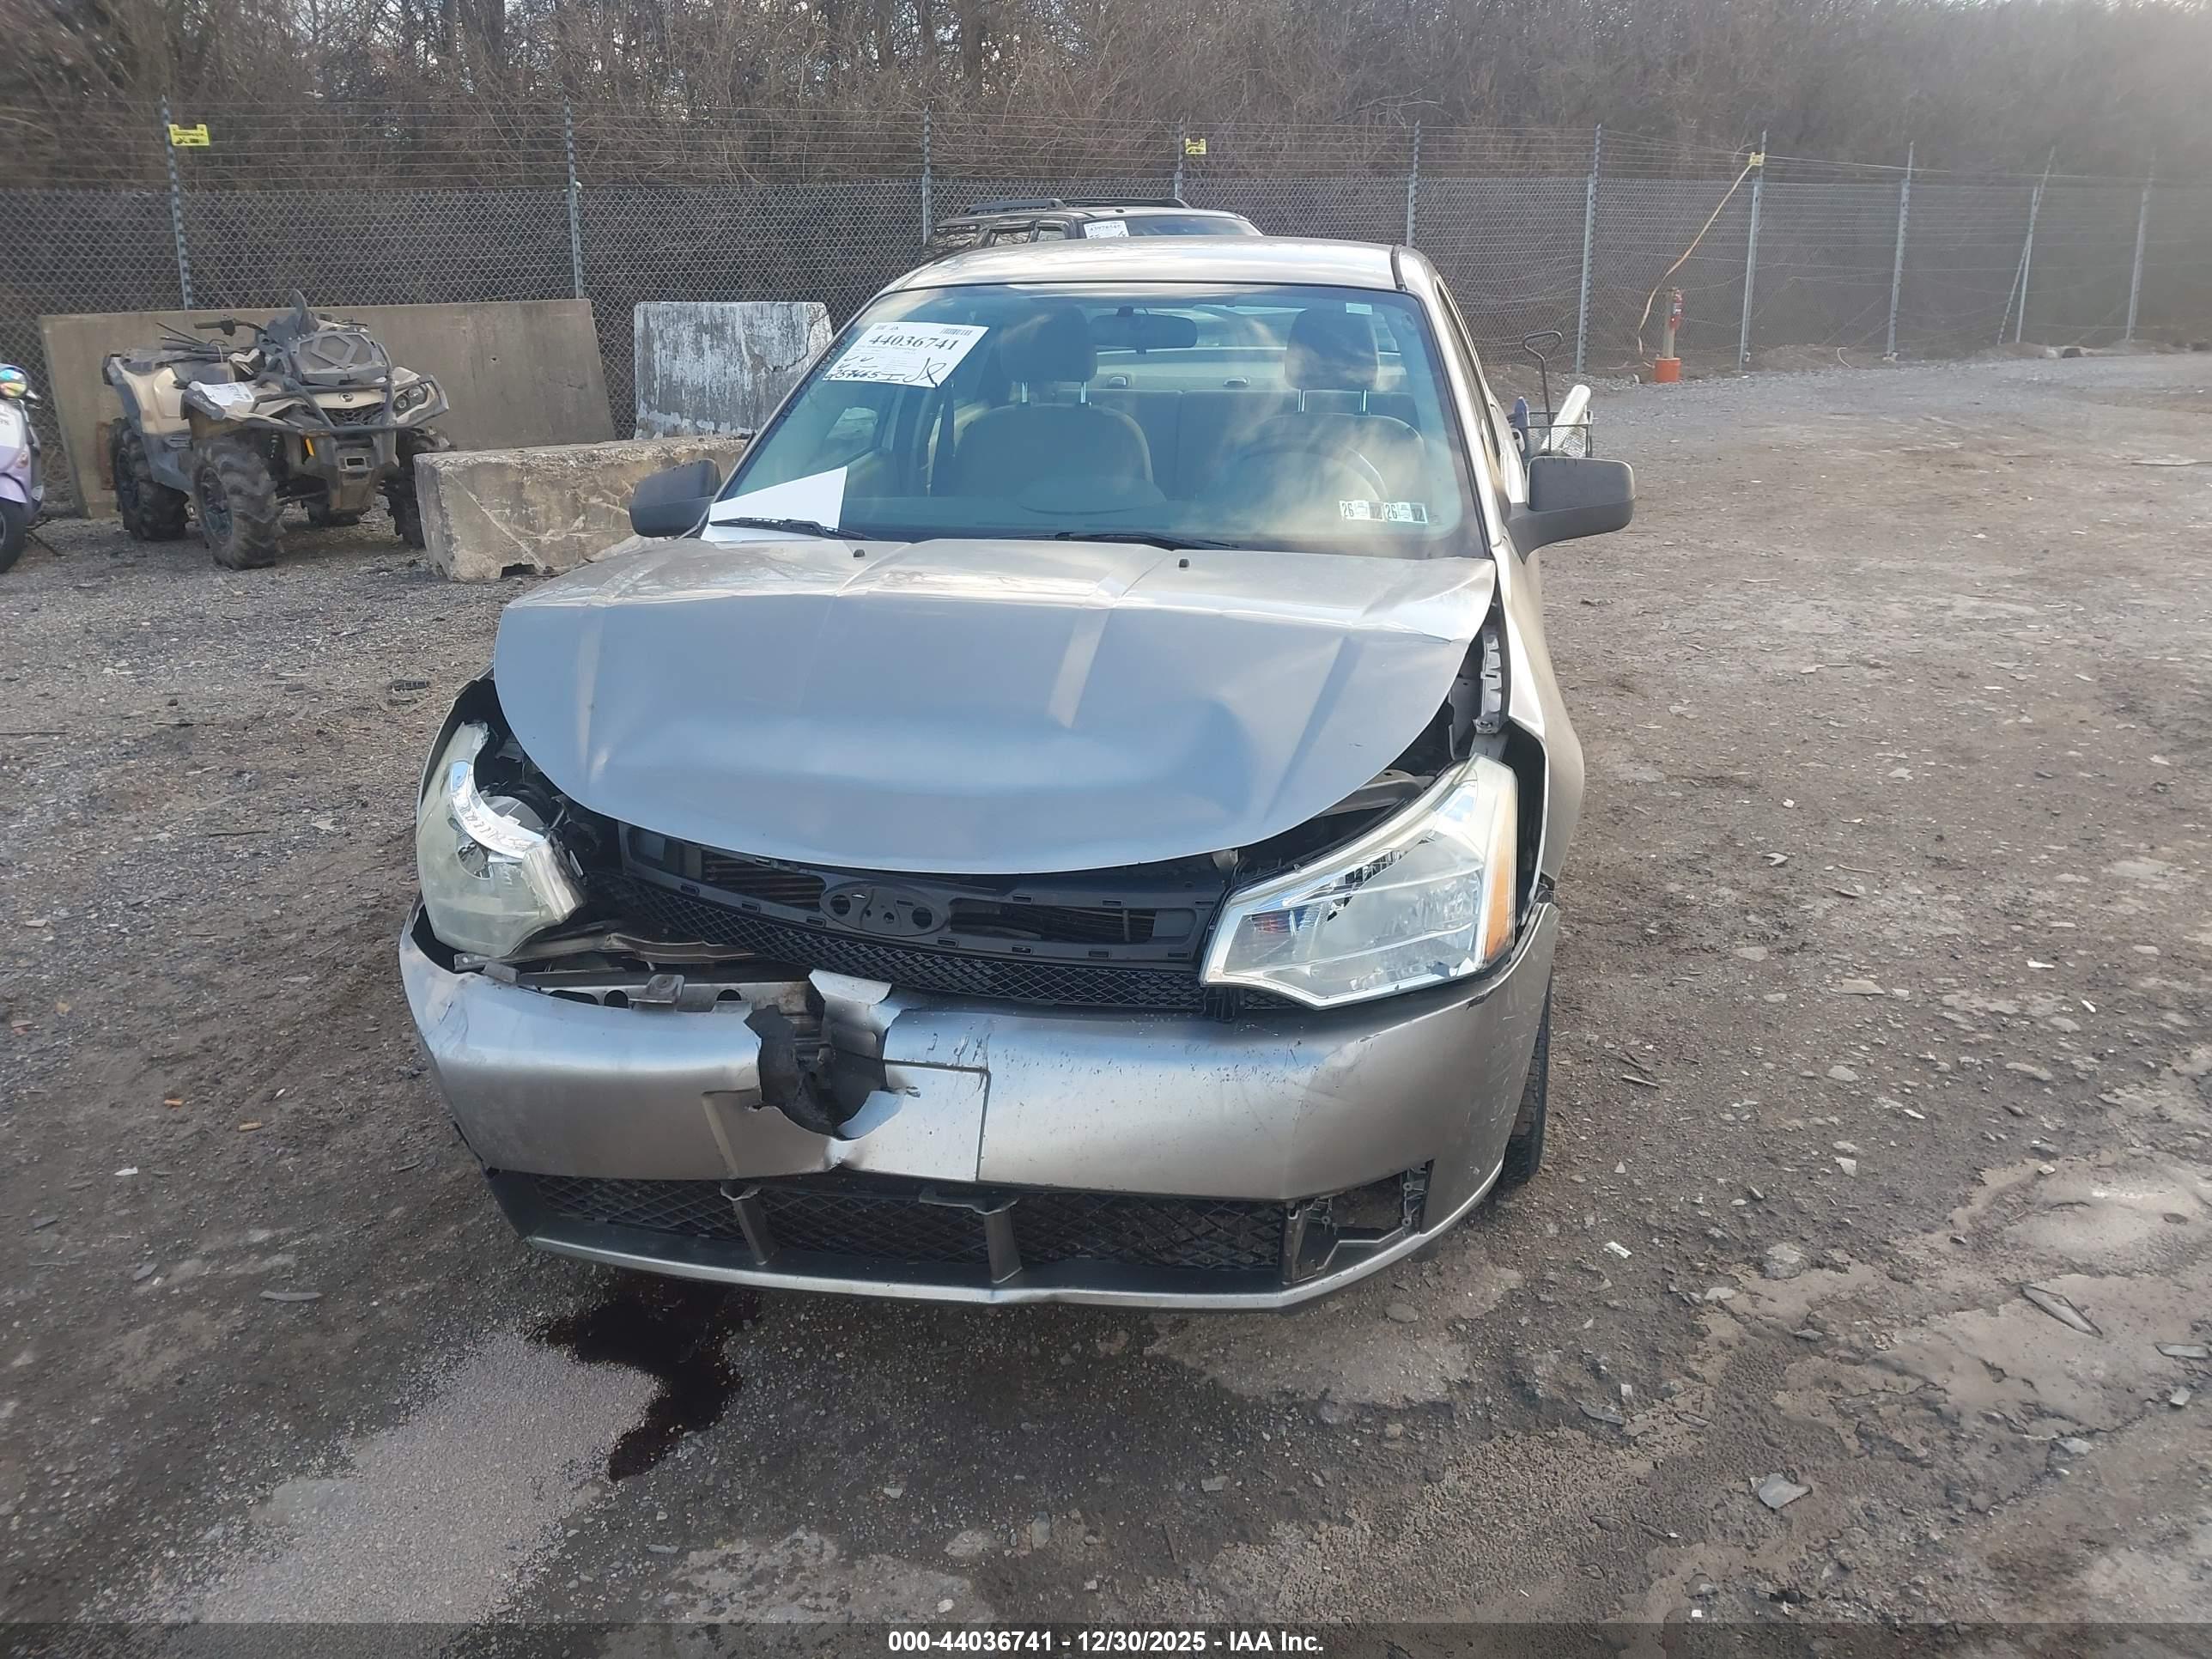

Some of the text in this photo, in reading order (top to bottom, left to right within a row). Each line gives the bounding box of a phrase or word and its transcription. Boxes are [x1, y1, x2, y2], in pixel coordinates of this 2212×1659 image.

[869, 334, 958, 350] 44036741
[1341, 502, 1354, 517] 26
[1385, 504, 1398, 519] 26
